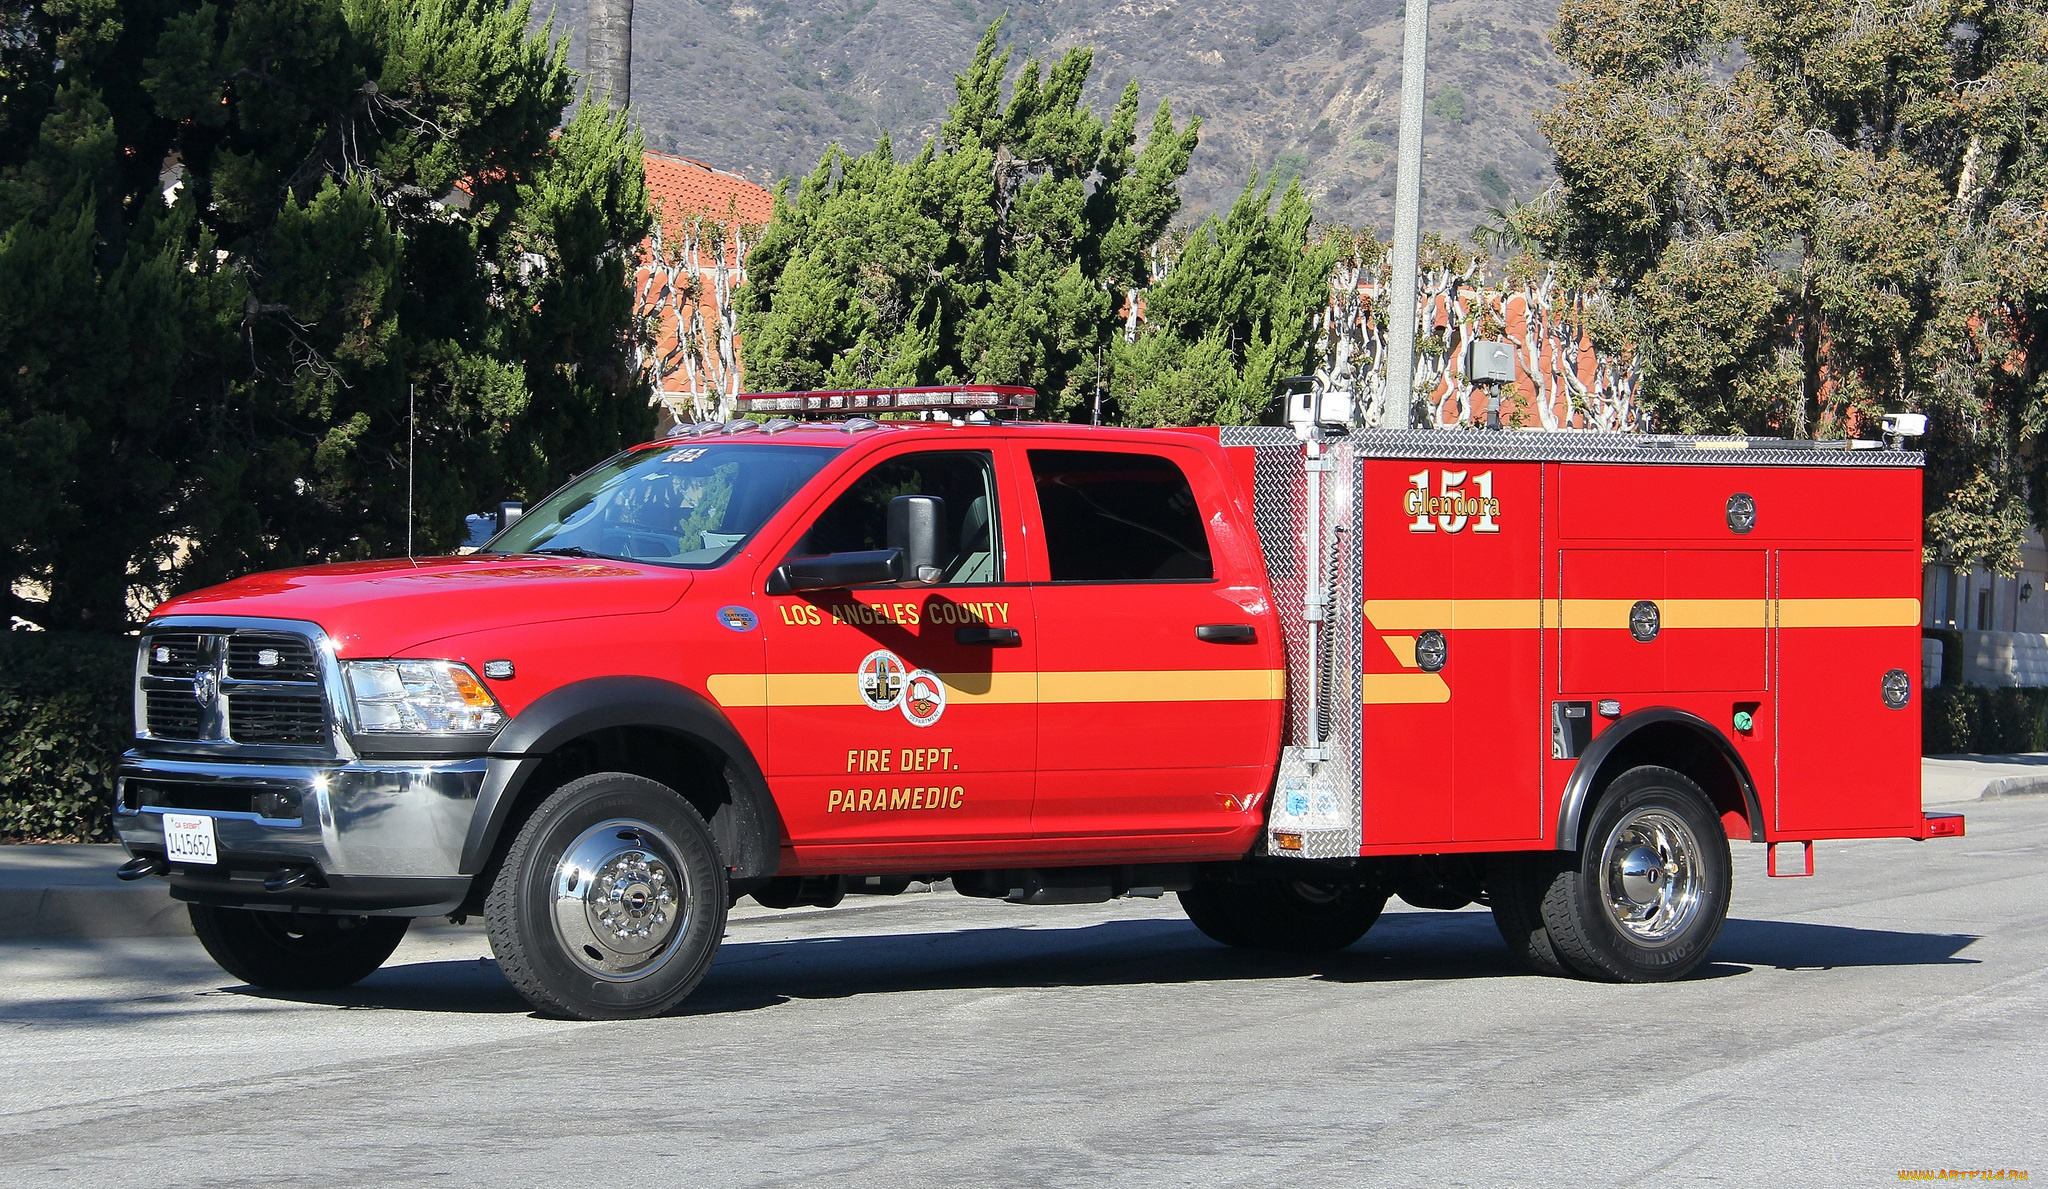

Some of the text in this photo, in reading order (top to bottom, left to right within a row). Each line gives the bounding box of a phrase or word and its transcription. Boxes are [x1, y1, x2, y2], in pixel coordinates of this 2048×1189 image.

[1403, 487, 1501, 517] Glendora
[1408, 468, 1500, 534] 151
[779, 602, 1009, 626] LOS ANGELES COUNTY
[908, 710, 940, 725] DEPARTMENT
[846, 747, 959, 773] FIRE DEPT.
[827, 785, 965, 813] PARAMEDIC
[175, 821, 182, 829] CA
[168, 832, 212, 857] 1415652
